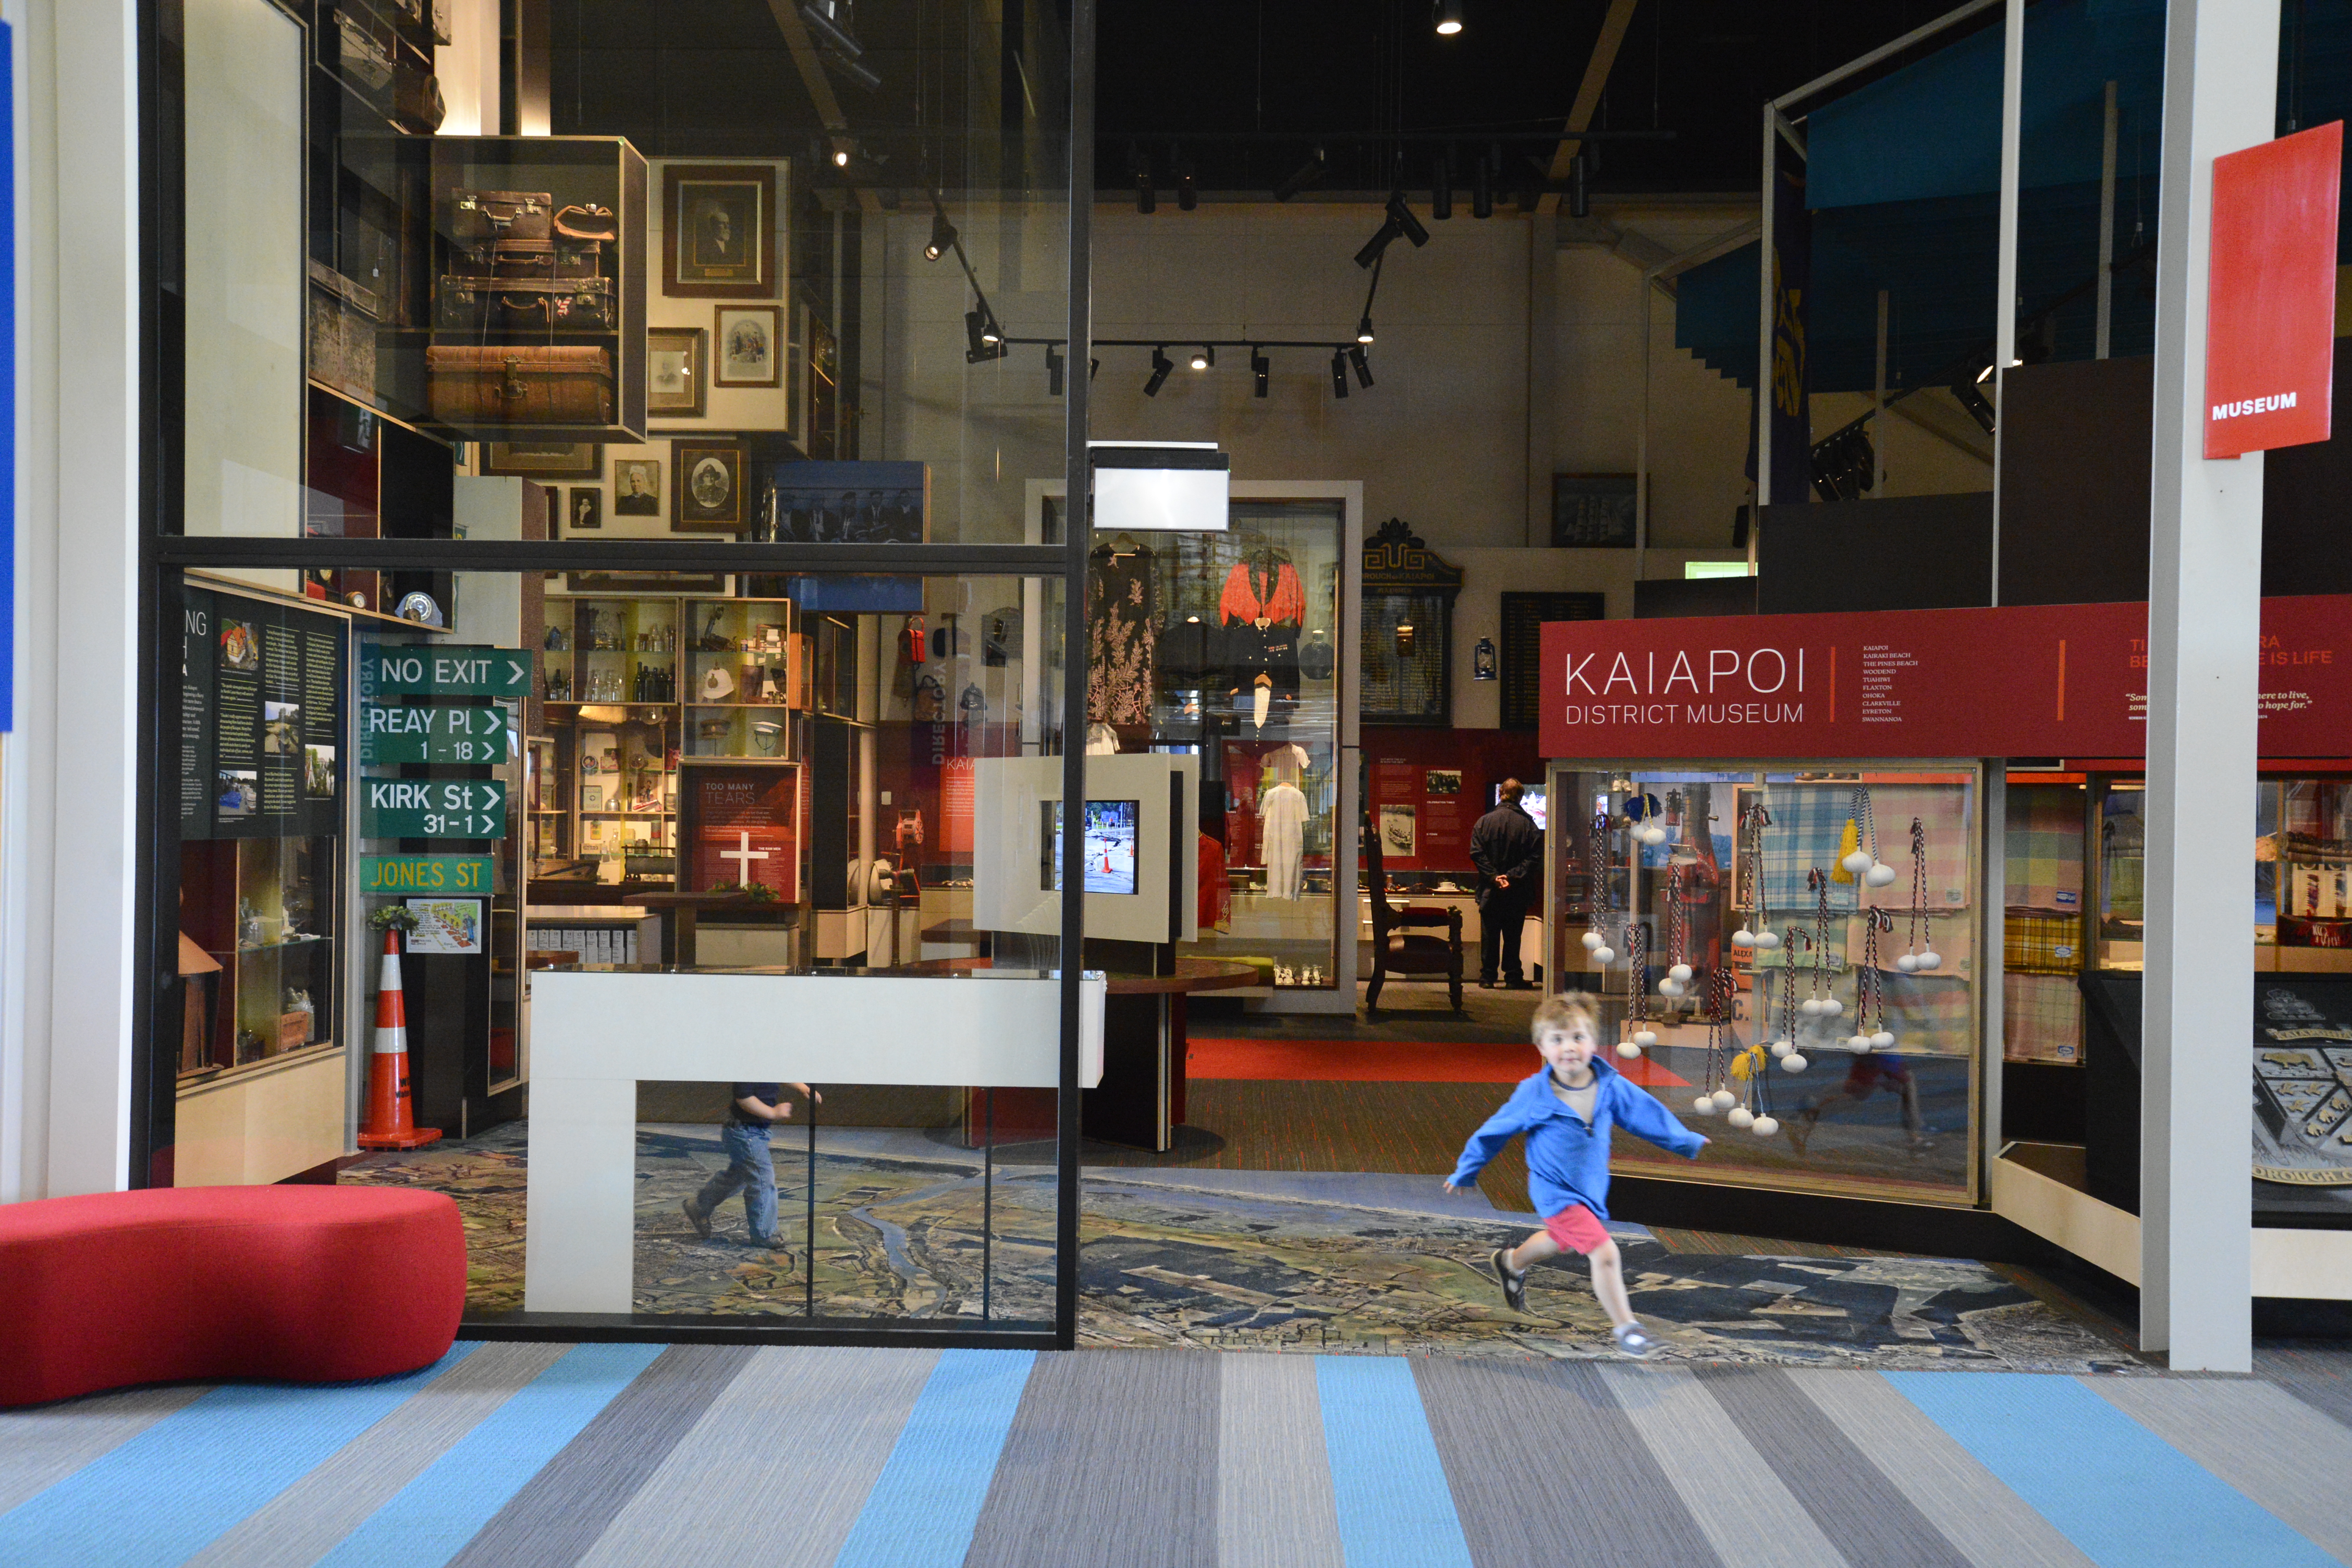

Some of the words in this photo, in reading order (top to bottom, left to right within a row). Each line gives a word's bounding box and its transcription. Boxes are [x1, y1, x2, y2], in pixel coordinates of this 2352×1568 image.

[2212, 391, 2296, 421] MUSEUM
[2271, 652, 2288, 665] IS
[2294, 651, 2332, 665] LIFE
[382, 658, 422, 682] NO
[435, 659, 492, 683] EXIT
[1566, 648, 1804, 695] KAIAPOI
[2265, 701, 2288, 710] hope
[2289, 691, 2310, 700] live,
[370, 709, 436, 733] REAY
[449, 709, 472, 734] Pl
[1566, 704, 1679, 724] DISTRICT
[1687, 703, 1803, 723] MUSEUM
[421, 742, 427, 760] 1
[454, 741, 473, 760] 18
[371, 784, 430, 808] KIRK
[444, 785, 473, 810] St
[705, 792, 755, 804] TEARS
[371, 862, 444, 886] JONES
[457, 863, 482, 886] ST
[2252, 1168, 2338, 1182] OROUGH
